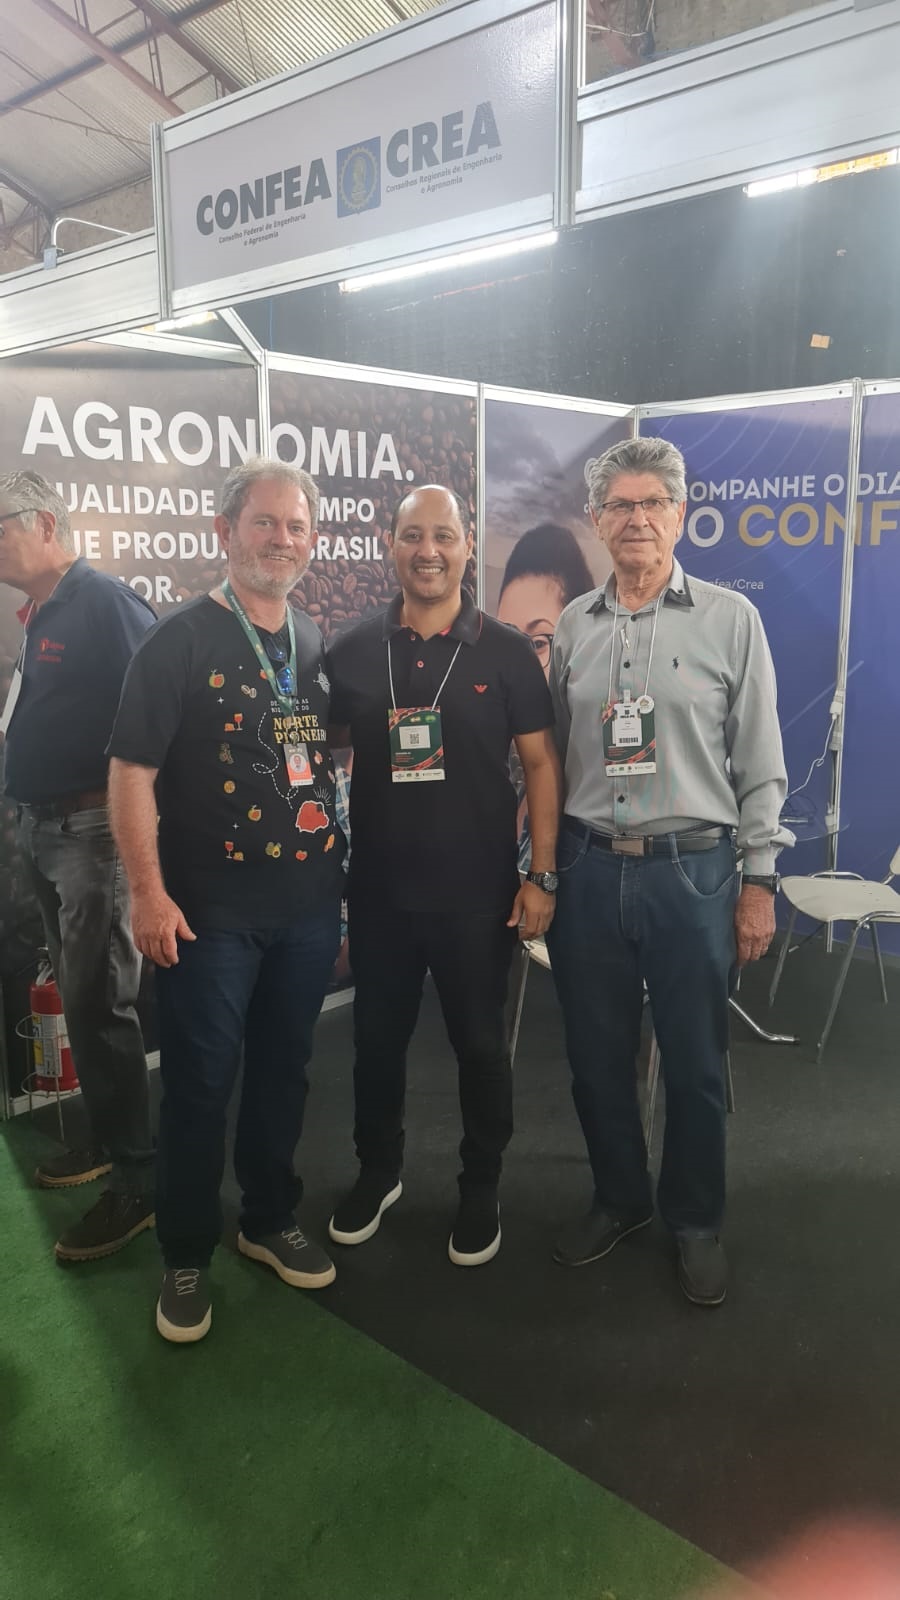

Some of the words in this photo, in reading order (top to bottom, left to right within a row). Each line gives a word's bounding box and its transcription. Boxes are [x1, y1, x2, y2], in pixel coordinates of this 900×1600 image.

[386, 100, 502, 178] CREA
[385, 178, 418, 193] Conselhos
[419, 167, 451, 184] Regionais
[452, 165, 461, 174] de
[462, 152, 503, 171] Engenharia
[426, 175, 463, 192] Agronomia
[196, 158, 332, 236] CONFEA
[218, 231, 243, 244] Conselho
[243, 224, 264, 236] Federal
[265, 222, 273, 230] de
[273, 213, 306, 228] Engenharia
[248, 231, 279, 246] Agronomia
[21, 395, 414, 481] AGRONOMIA.
[55, 482, 215, 517] UALIDADE
[319, 496, 375, 523] MPO
[688, 474, 816, 502] OMPANHE
[823, 473, 845, 496] O
[687, 505, 724, 548] O
[112, 530, 228, 560] PRODU
[310, 535, 384, 560] RASIL
[709, 577, 764, 590] fea/Crea
[272, 714, 319, 730] NORTE
[274, 728, 327, 744] PINEIR
